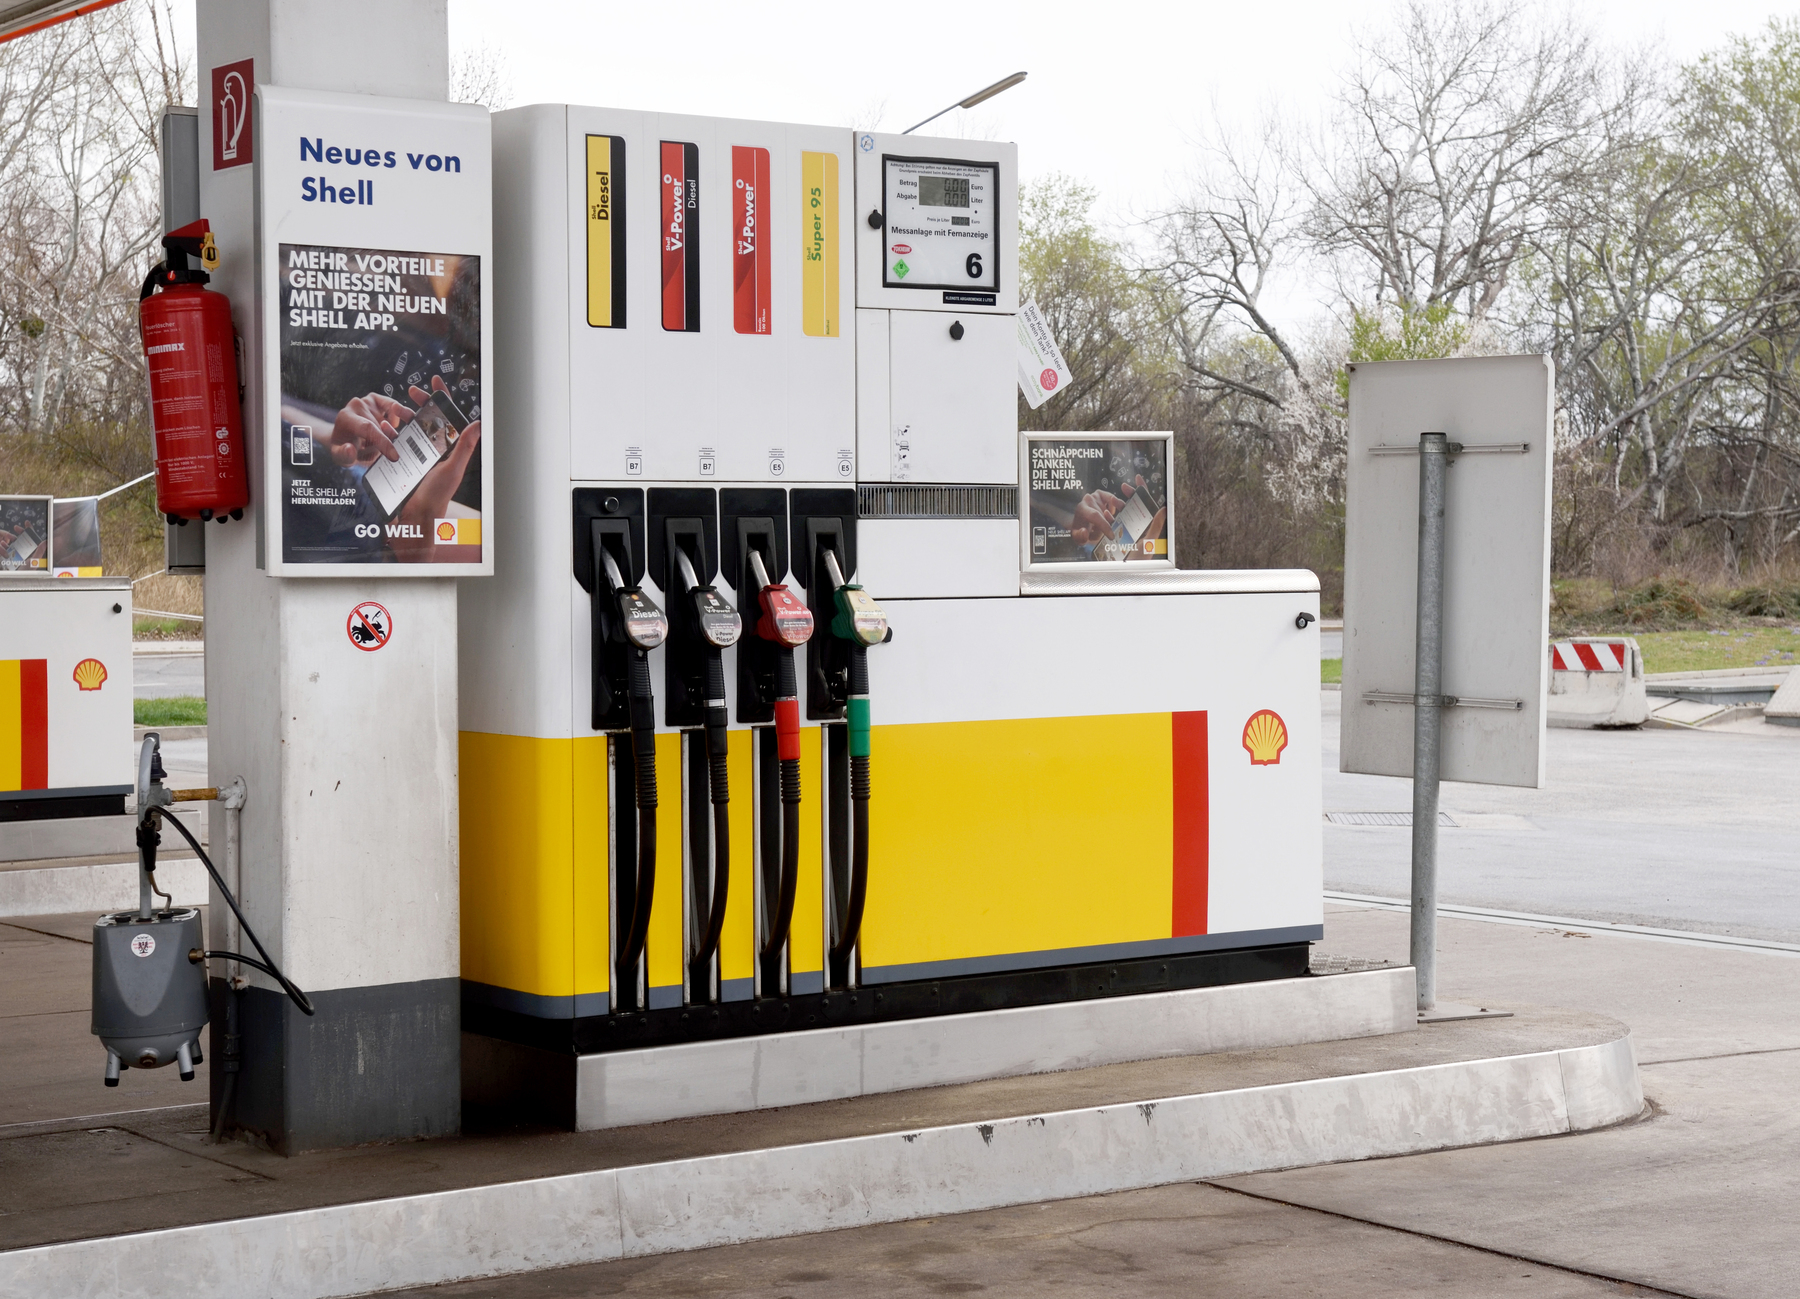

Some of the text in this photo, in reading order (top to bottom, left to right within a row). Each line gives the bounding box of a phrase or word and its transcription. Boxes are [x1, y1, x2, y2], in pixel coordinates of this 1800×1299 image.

[300, 136, 461, 173] Neues von
[301, 176, 373, 206] Shell
[596, 171, 609, 220] Diesel
[687, 179, 697, 209] Diesel
[671, 178, 683, 251] V-Power
[743, 183, 755, 255] V-Power
[811, 187, 824, 262] Super 95
[891, 226, 988, 239] Messanlage mit Fernanzeige
[288, 250, 444, 276] MEHR VORTEILE
[966, 252, 983, 279] 6
[289, 270, 408, 294] GENIESSEN.
[289, 290, 446, 314] MIT DER NEUEN
[290, 309, 398, 332] SHELL APP.
[1024, 311, 1032, 322] wie
[1030, 323, 1038, 337] dein
[1037, 336, 1049, 356] Tank?
[1029, 306, 1037, 321] Dein
[1036, 321, 1047, 340] Konto
[1050, 348, 1055, 358] so
[1054, 356, 1062, 371] leer
[1032, 446, 1103, 458] SCHNÄPPCHEN
[1032, 460, 1074, 469] TANKEN.
[1033, 470, 1075, 479] DIE NEUE
[292, 488, 356, 497] NEUE SHELL APP
[1033, 480, 1084, 490] SHELL APP.
[292, 497, 356, 506] HERUNTERLADEN
[354, 524, 424, 538] GO WELL
[1105, 543, 1138, 552] GO WELL
[632, 610, 660, 618] Diesel
